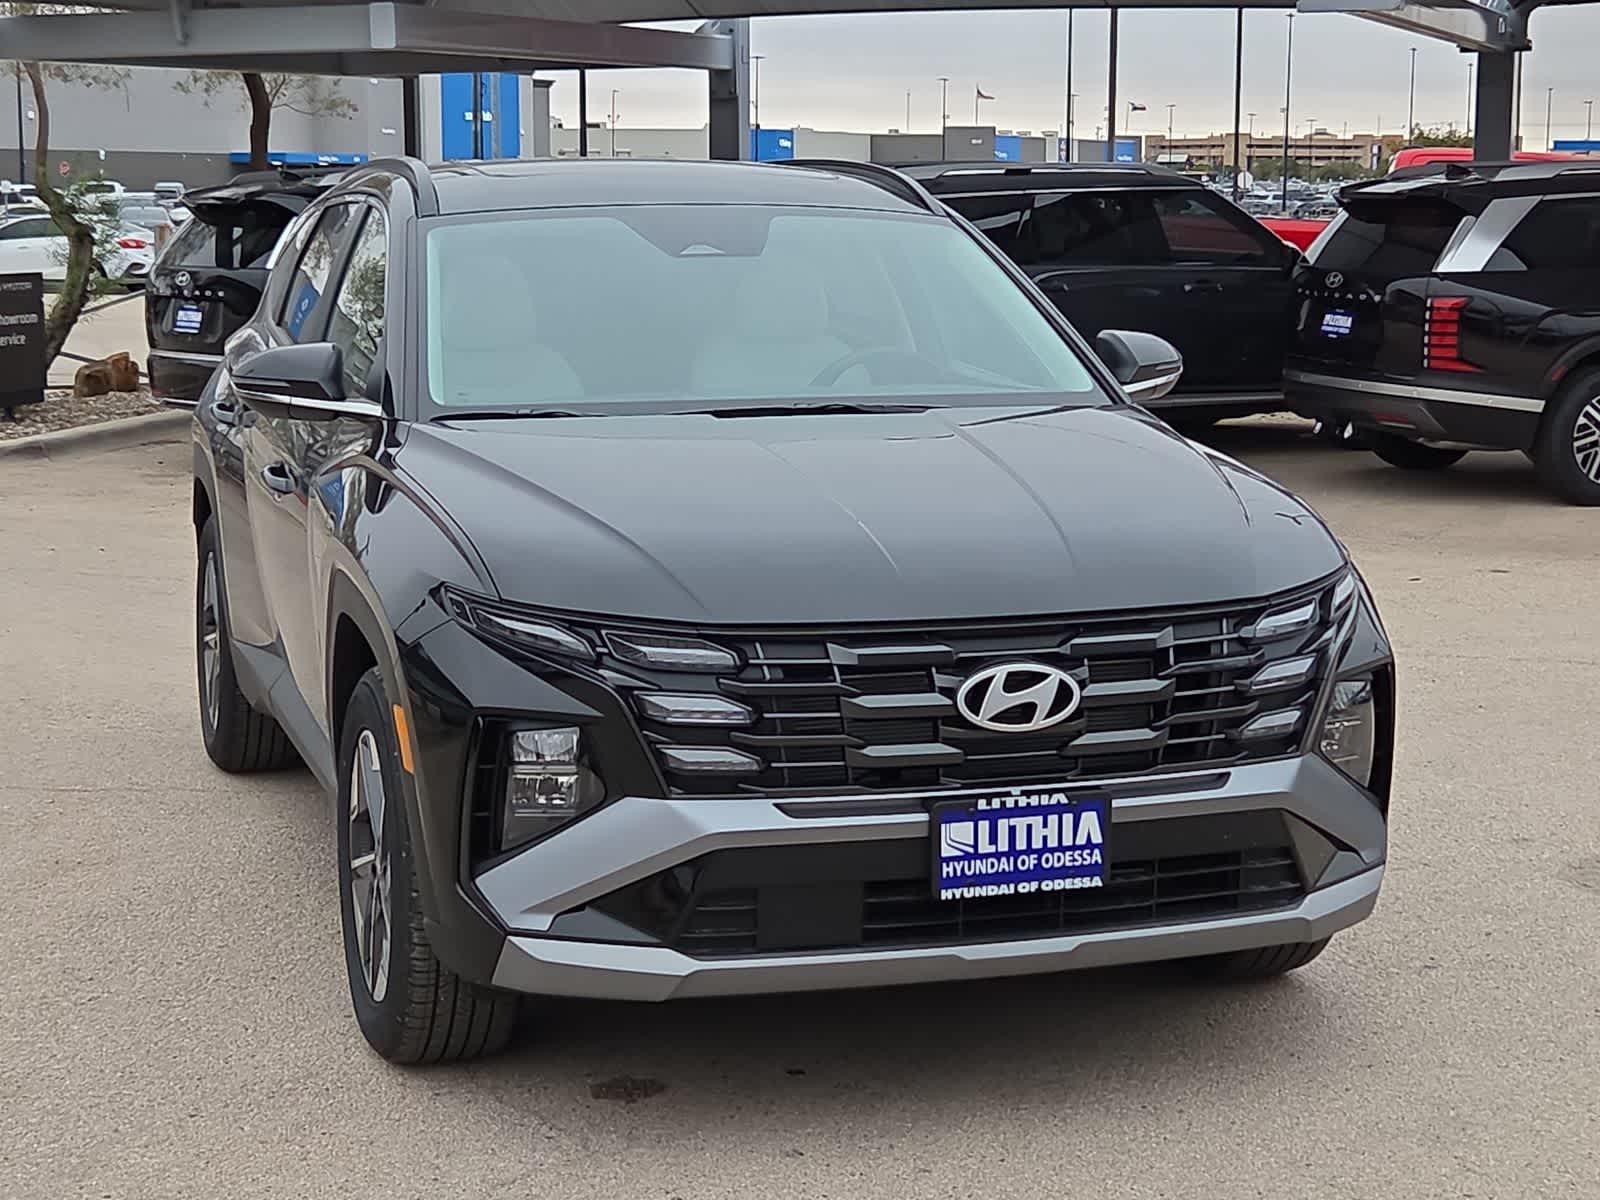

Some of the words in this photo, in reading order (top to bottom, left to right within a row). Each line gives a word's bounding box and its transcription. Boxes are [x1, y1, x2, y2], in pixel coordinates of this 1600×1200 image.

[977, 793, 1069, 810] LITHIA
[977, 811, 1103, 854] LITHIA
[942, 856, 1014, 879] HYUNDAI
[1017, 854, 1038, 871] OF
[1041, 848, 1102, 869] ODESSA
[941, 883, 1015, 901] HYUNDAI
[1017, 881, 1039, 893] OF
[1041, 876, 1103, 891] ODESSA
